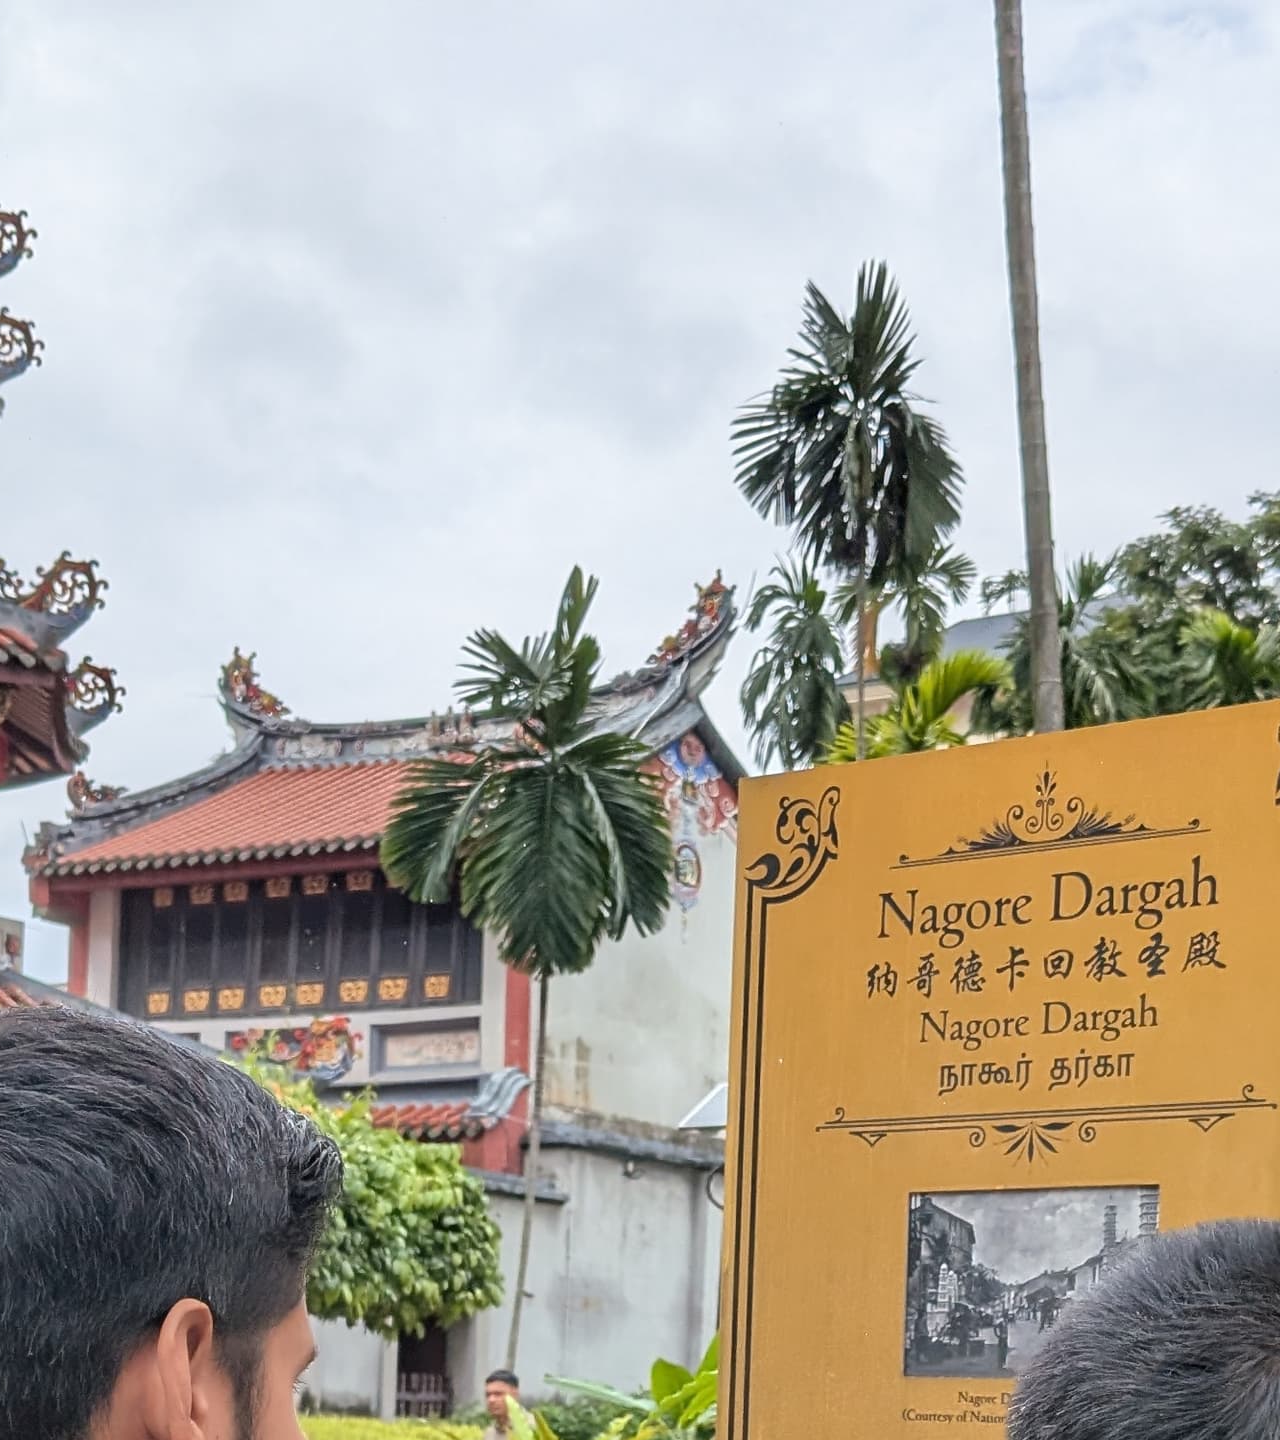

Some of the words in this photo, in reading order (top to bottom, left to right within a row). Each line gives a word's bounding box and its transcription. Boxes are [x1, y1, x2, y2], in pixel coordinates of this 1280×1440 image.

[877, 886, 1032, 949] Nagore
[1051, 854, 1219, 930] Dargah
[866, 930, 1227, 1000] 纳哥德卡回教圣殿
[919, 1009, 1030, 1058] Nagore
[1042, 993, 1158, 1049] Dargah
[938, 1051, 1034, 1097] நாகூர்
[1049, 1049, 1135, 1092] தர்கா
[902, 1408, 954, 1424] (Courtesy
[956, 1410, 968, 1422] of
[958, 1391, 997, 1407] Nagore
